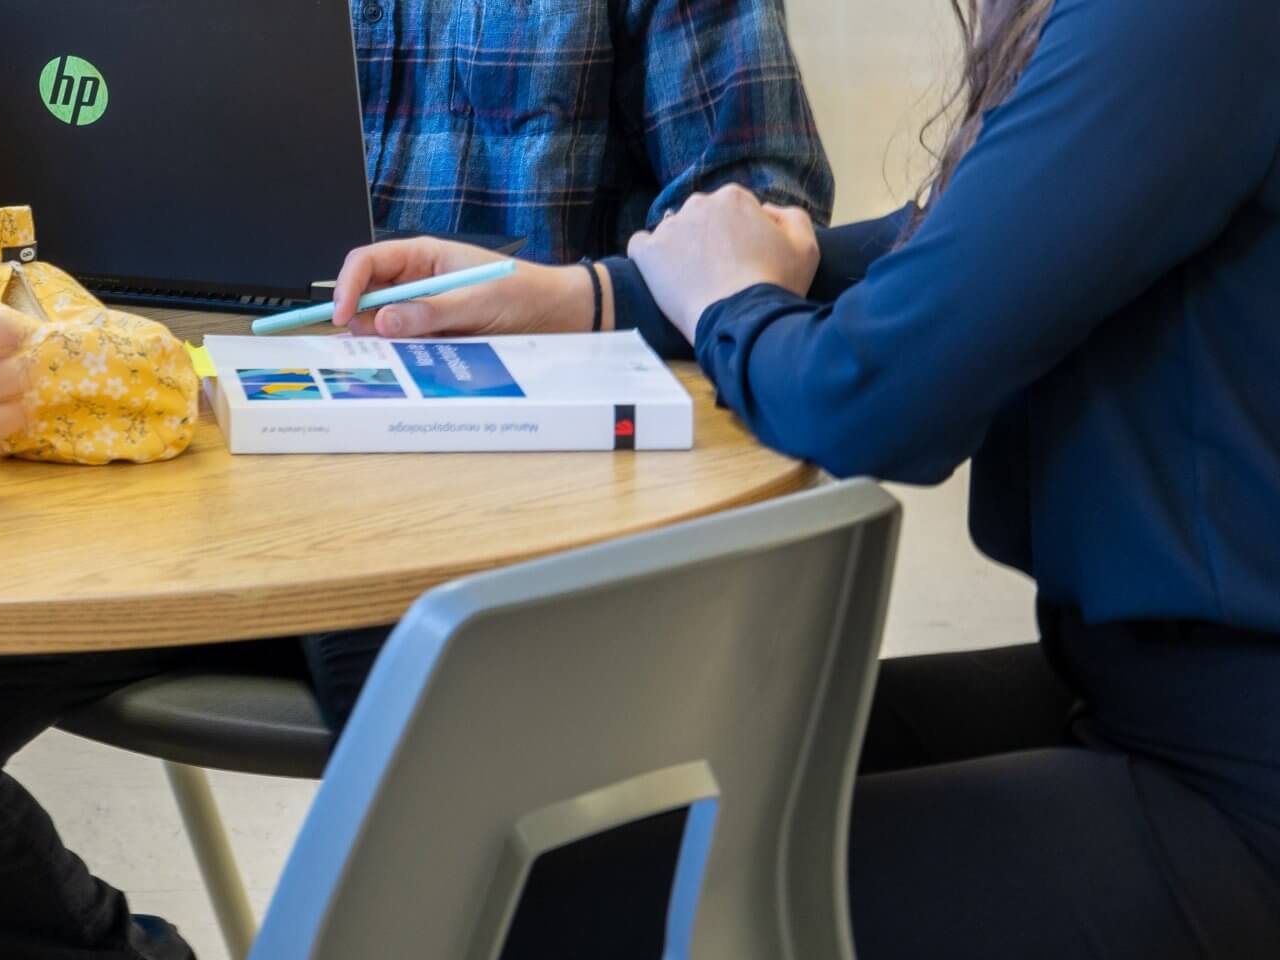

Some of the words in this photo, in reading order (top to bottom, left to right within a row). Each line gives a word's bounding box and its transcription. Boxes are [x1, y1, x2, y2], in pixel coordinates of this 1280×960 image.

[46, 55, 102, 126] hp
[387, 420, 481, 435] neuropsychologie
[483, 422, 497, 434] de
[500, 422, 539, 434] Manuel
